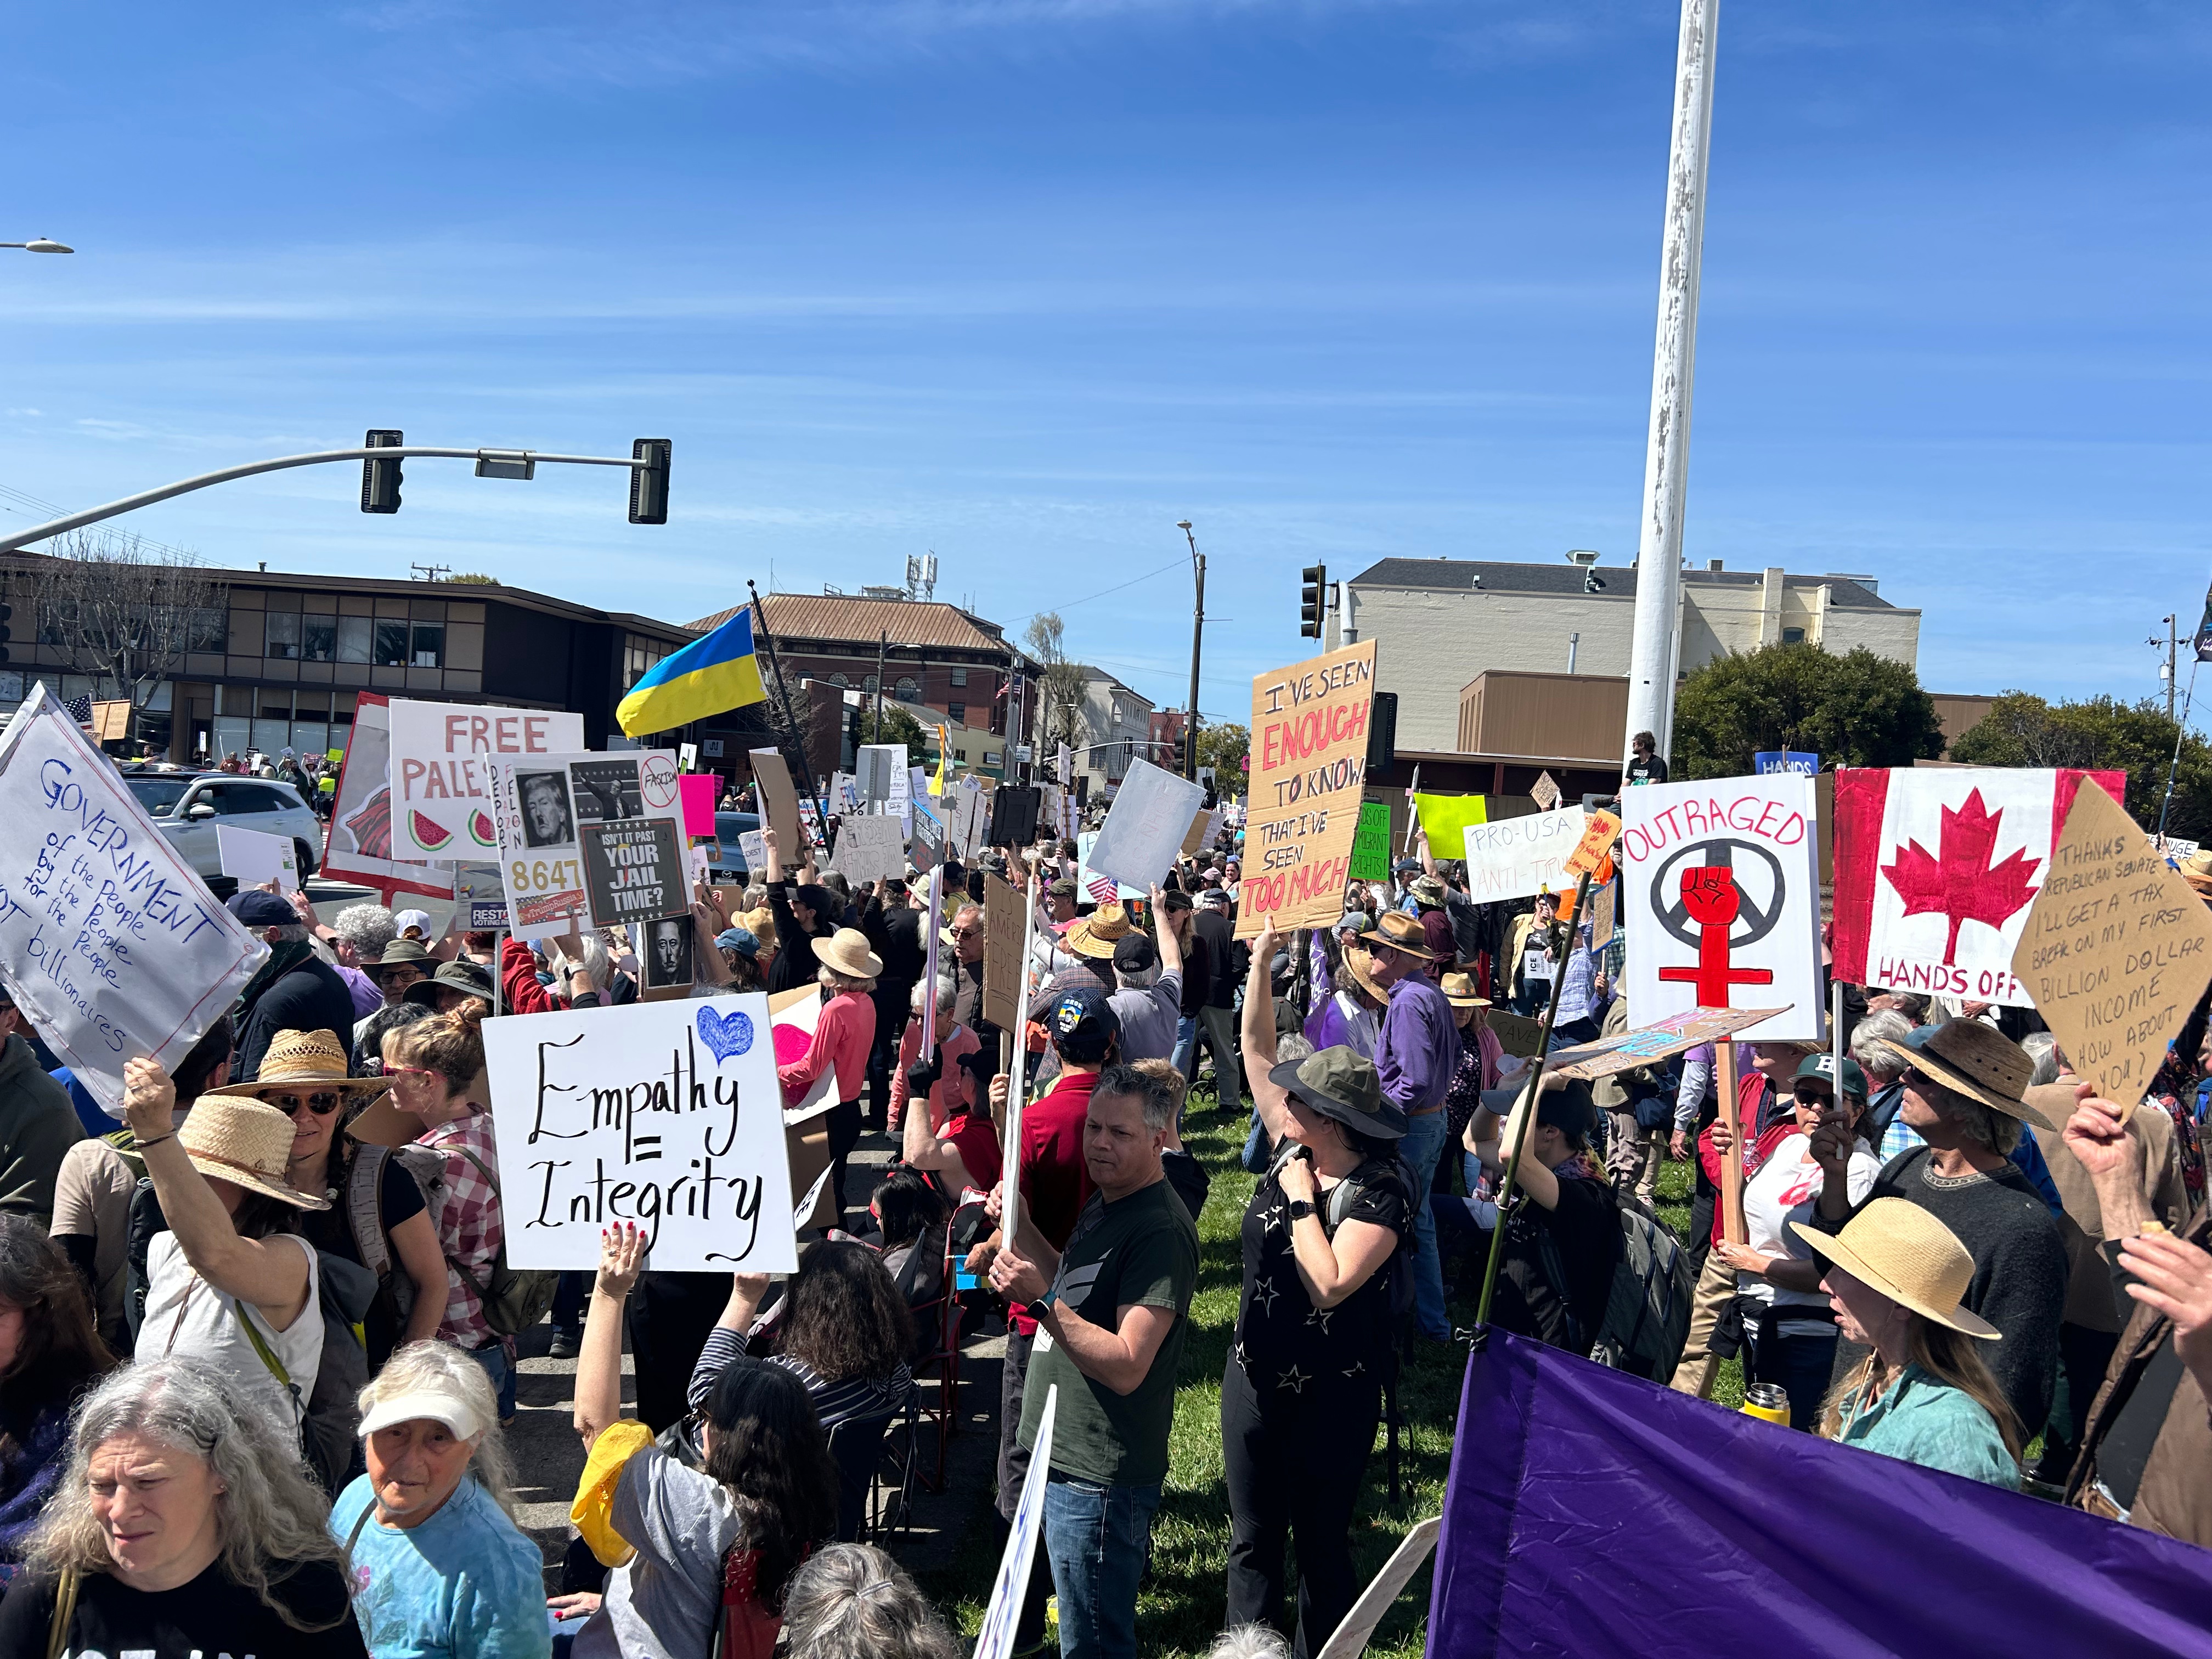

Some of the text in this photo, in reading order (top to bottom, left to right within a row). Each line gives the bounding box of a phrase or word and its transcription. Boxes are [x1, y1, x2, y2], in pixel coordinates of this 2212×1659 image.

[1266, 659, 1370, 714] I'VE SEEN
[445, 715, 549, 753] FREE
[1262, 699, 1369, 771] ENOUGH
[402, 759, 490, 801] PALE
[645, 772, 678, 788] FASCISM
[490, 765, 506, 860] DEPORT
[1261, 810, 1329, 847] THAT I'VE
[1373, 809, 1387, 827] OFF
[1471, 816, 1571, 851] PRO-USA
[1624, 797, 1804, 862] OUTRAGED
[41, 759, 224, 943] GOVERNMENT
[602, 831, 656, 845] ISN'T IT PAST
[605, 843, 659, 867] YOUR
[1261, 843, 1304, 872] SEEN
[1356, 831, 1388, 850] MIGRANT
[2060, 836, 2125, 866] THANKS
[38, 849, 54, 884] by
[61, 877, 79, 905] the
[46, 832, 74, 859] of
[74, 854, 93, 889] the
[511, 859, 582, 891] 8647
[610, 865, 663, 889] JAIL
[1353, 854, 1386, 876] RIGHTS!
[1477, 856, 1568, 898] ANTI-TRU
[2045, 856, 2159, 896] REPUBLICAN SENATE
[25, 868, 47, 898] for
[47, 900, 66, 927] the
[529, 896, 576, 918] TrumpRussia
[611, 887, 664, 912] TIME?
[1244, 857, 1349, 917] TOO MUCH
[2065, 900, 2103, 929] GET
[2107, 894, 2119, 912] A
[2129, 884, 2164, 904] TAX
[990, 911, 1024, 946] AMERIC
[2032, 907, 2188, 970] BREAK ON MY FIRST
[0, 884, 125, 1052] OT billionaires
[1878, 956, 2018, 1000] HANDS OFF
[2040, 937, 2205, 1005] BILLION DOLLAR
[2085, 969, 2163, 1029] INCOME
[1496, 1022, 1537, 1045] SAVE
[2079, 1005, 2177, 1069] HOW ABOUT
[527, 1025, 739, 1166] Empathy
[633, 1136, 662, 1162] =
[524, 1156, 763, 1262] Integrity
